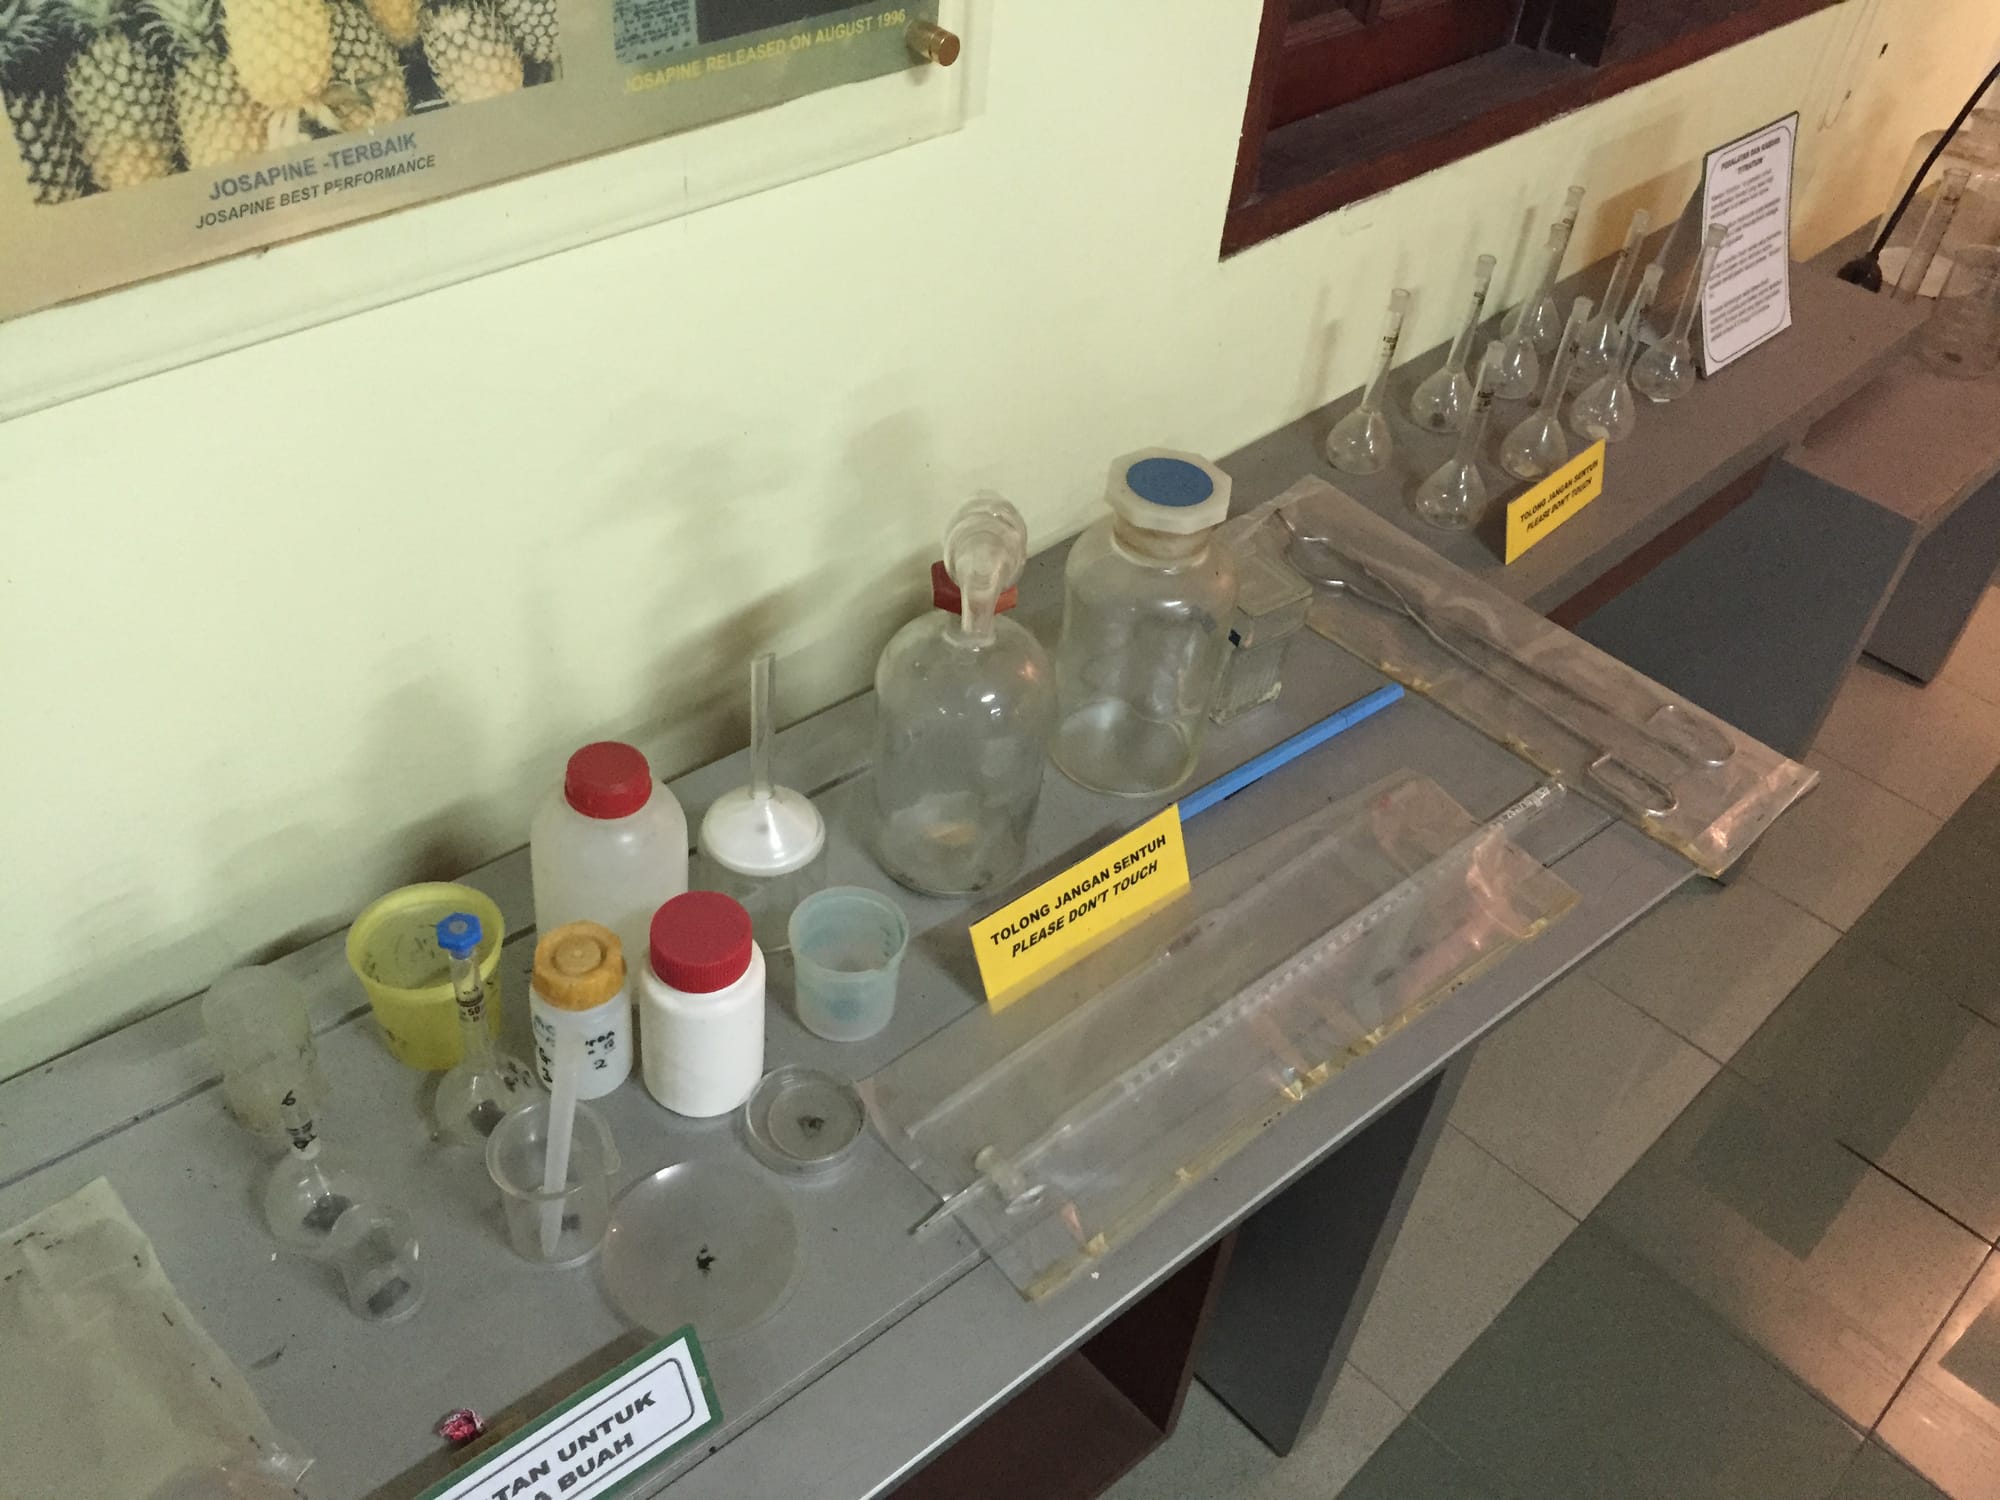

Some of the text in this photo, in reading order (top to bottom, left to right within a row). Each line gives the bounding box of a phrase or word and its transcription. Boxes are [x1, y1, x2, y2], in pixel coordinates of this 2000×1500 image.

[625, 9, 906, 93] JOSAPINE RELEASED ON AUGUST 1996
[196, 154, 436, 229] JOSAPINE BEST PERFORMANCE
[209, 157, 318, 201] JOSAPINE
[1520, 459, 1598, 522] TOLONG JANGAN SENTUH
[1526, 508, 1551, 533] PLEASE
[1551, 493, 1570, 513] DON'T
[990, 834, 1166, 946] TOLONG JANGAN SENTUH
[1012, 860, 1158, 958] PLEASE DON'T TOUCH
[485, 1390, 657, 1500] TAN UNTUK
[557, 1432, 634, 1493] BUAH
